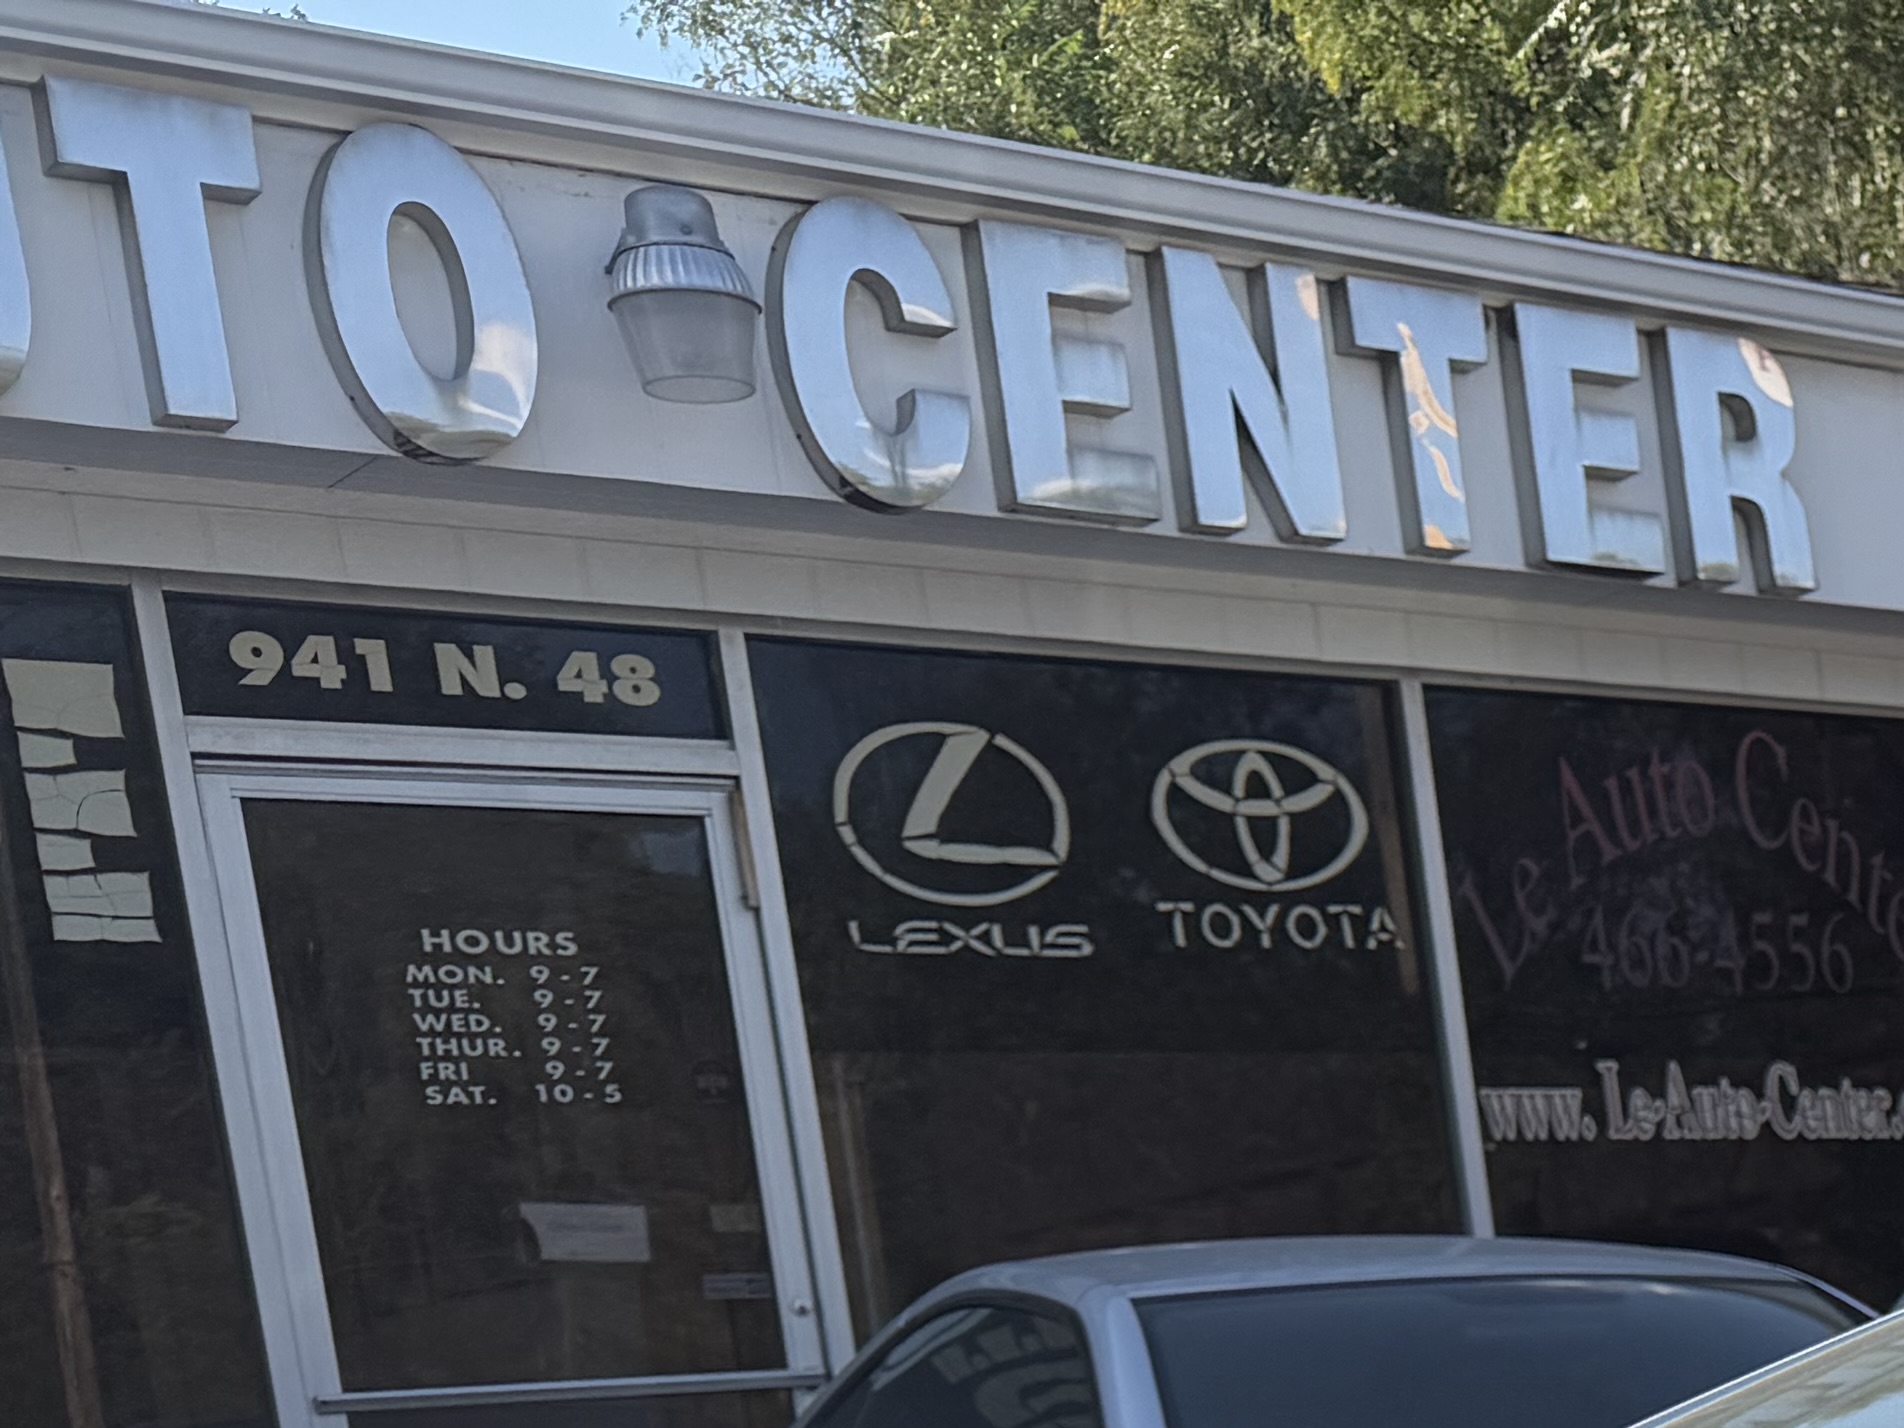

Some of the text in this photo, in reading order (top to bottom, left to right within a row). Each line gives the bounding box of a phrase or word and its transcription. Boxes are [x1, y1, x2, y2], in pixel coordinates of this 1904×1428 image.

[0, 75, 1816, 595] TO CENTER
[229, 630, 661, 707] 941 N. 48
[1557, 744, 1715, 891] Auto
[847, 920, 1095, 958] LEXUS
[1155, 902, 1405, 950] TOYOTA
[420, 928, 579, 956] HOURS
[1580, 907, 1855, 994] 466-4556
[406, 964, 506, 985] MON.
[408, 988, 481, 1009] TUE.
[412, 1013, 502, 1033] WED.
[416, 1036, 522, 1057] THUR.
[419, 1061, 470, 1081] FRI
[425, 1085, 497, 1105] SAT.
